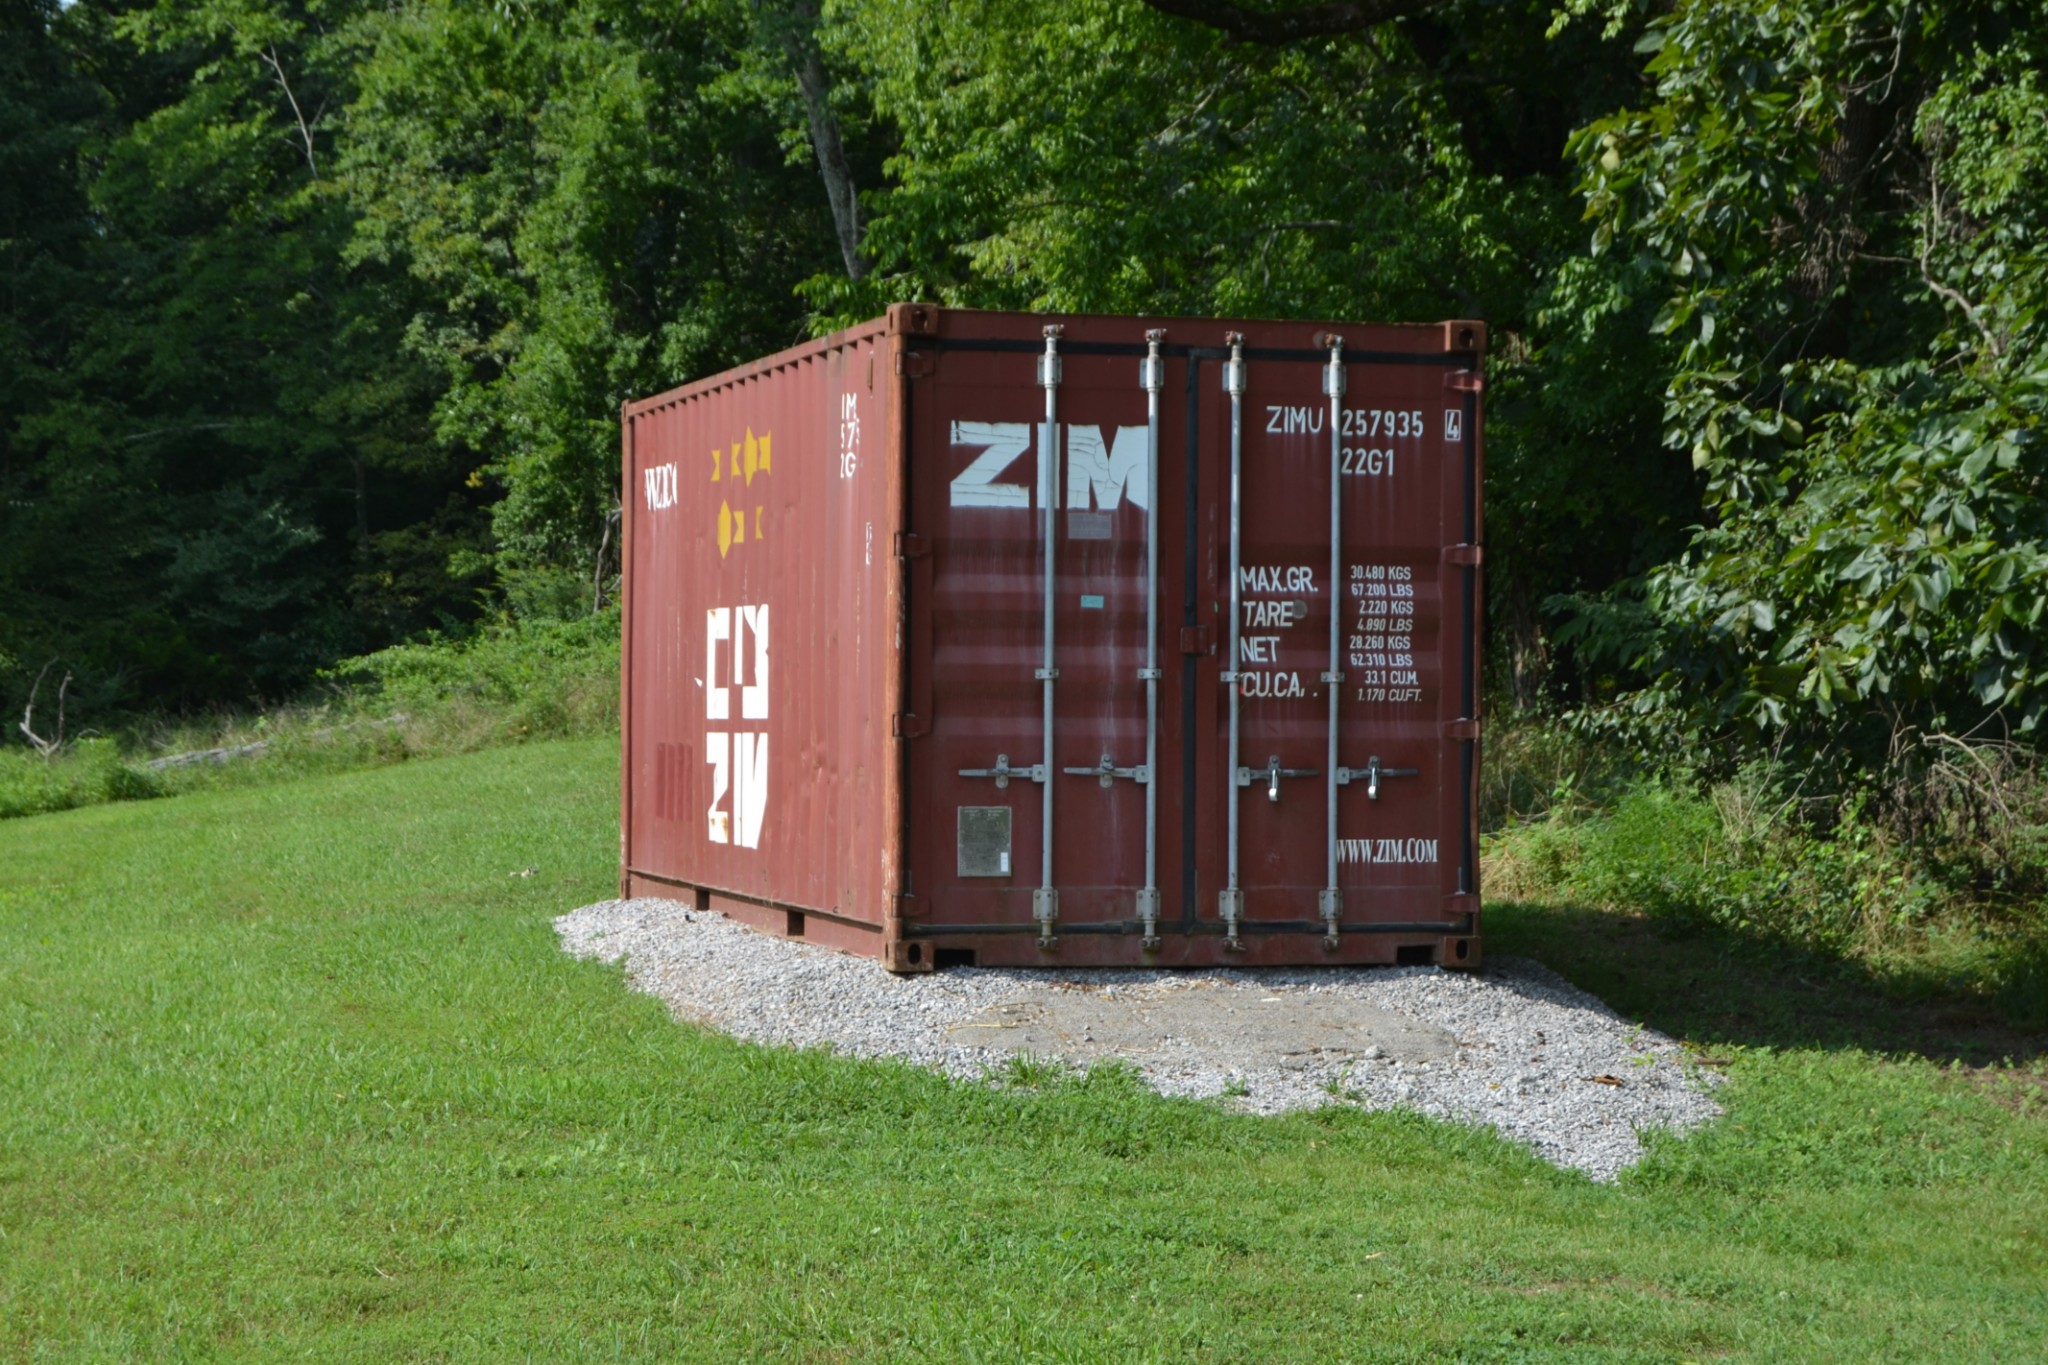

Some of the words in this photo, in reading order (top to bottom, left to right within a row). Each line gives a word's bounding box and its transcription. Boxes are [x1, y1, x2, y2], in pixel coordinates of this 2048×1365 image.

[1266, 405, 1324, 434] ZIMU
[1341, 409, 1424, 437] 257935
[1446, 411, 1460, 439] 4
[950, 420, 1149, 510] ZIM
[1341, 447, 1395, 476] 22G1
[1240, 566, 1319, 593] MAX.GR.
[1350, 565, 1385, 580] 30.480
[1388, 566, 1412, 580] KGS
[1351, 583, 1387, 596] 67.200
[1389, 584, 1414, 597] LBS
[1243, 601, 1294, 627] TARE
[1359, 600, 1387, 614] 2.220
[1391, 600, 1414, 614] KGS
[1357, 618, 1386, 632] 4.890
[1389, 619, 1413, 632] LBS
[1240, 636, 1281, 663] NET
[1350, 635, 1385, 649] 28.260
[1387, 636, 1411, 650] KGS
[1350, 654, 1385, 667] 62.310
[1389, 654, 1413, 667] LBS
[1365, 670, 1386, 685] 33.1
[1358, 688, 1385, 702] 1.170
[1336, 837, 1438, 863] WWW.ZIM.COM
